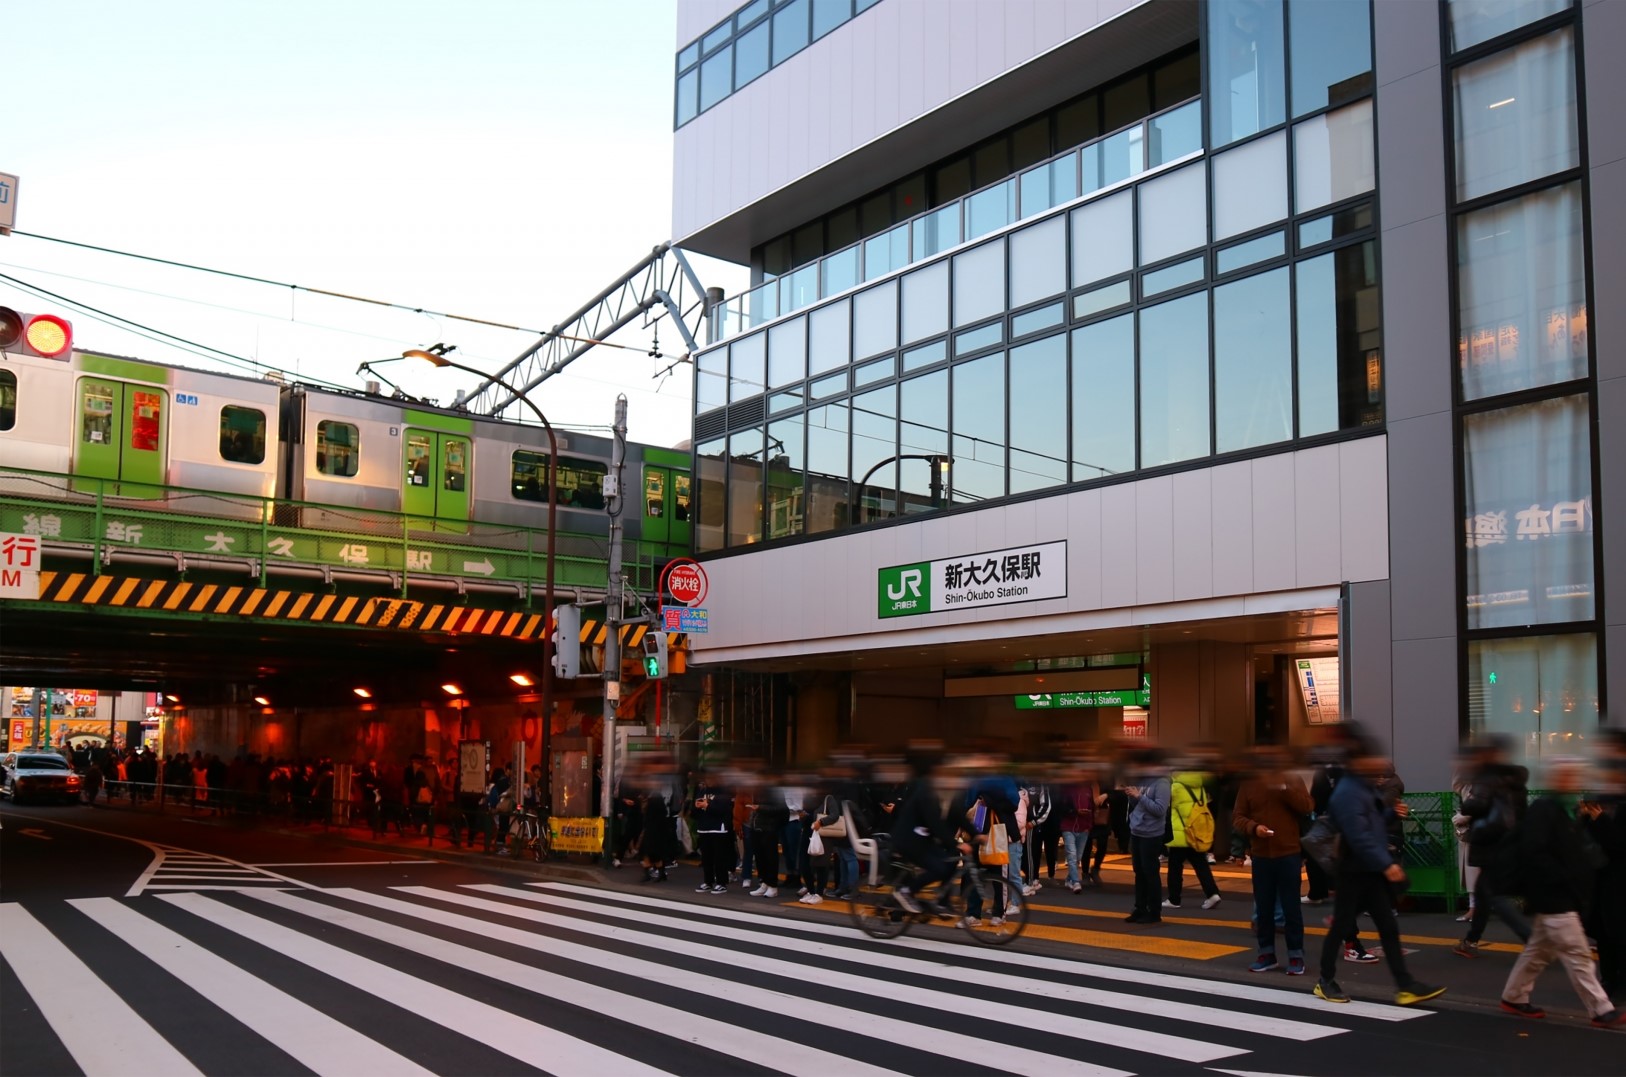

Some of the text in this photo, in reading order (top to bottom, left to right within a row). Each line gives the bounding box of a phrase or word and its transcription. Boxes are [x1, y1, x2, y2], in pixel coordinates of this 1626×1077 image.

[2, 536, 37, 566] 行
[2, 569, 21, 587] M
[945, 552, 1041, 590] 新大久保駅
[671, 576, 699, 591] 消火栓
[887, 568, 922, 600] JR
[945, 585, 1028, 605] Shin-Ōkubo Station
[664, 609, 681, 631] 質
[1098, 694, 1122, 705] Station
